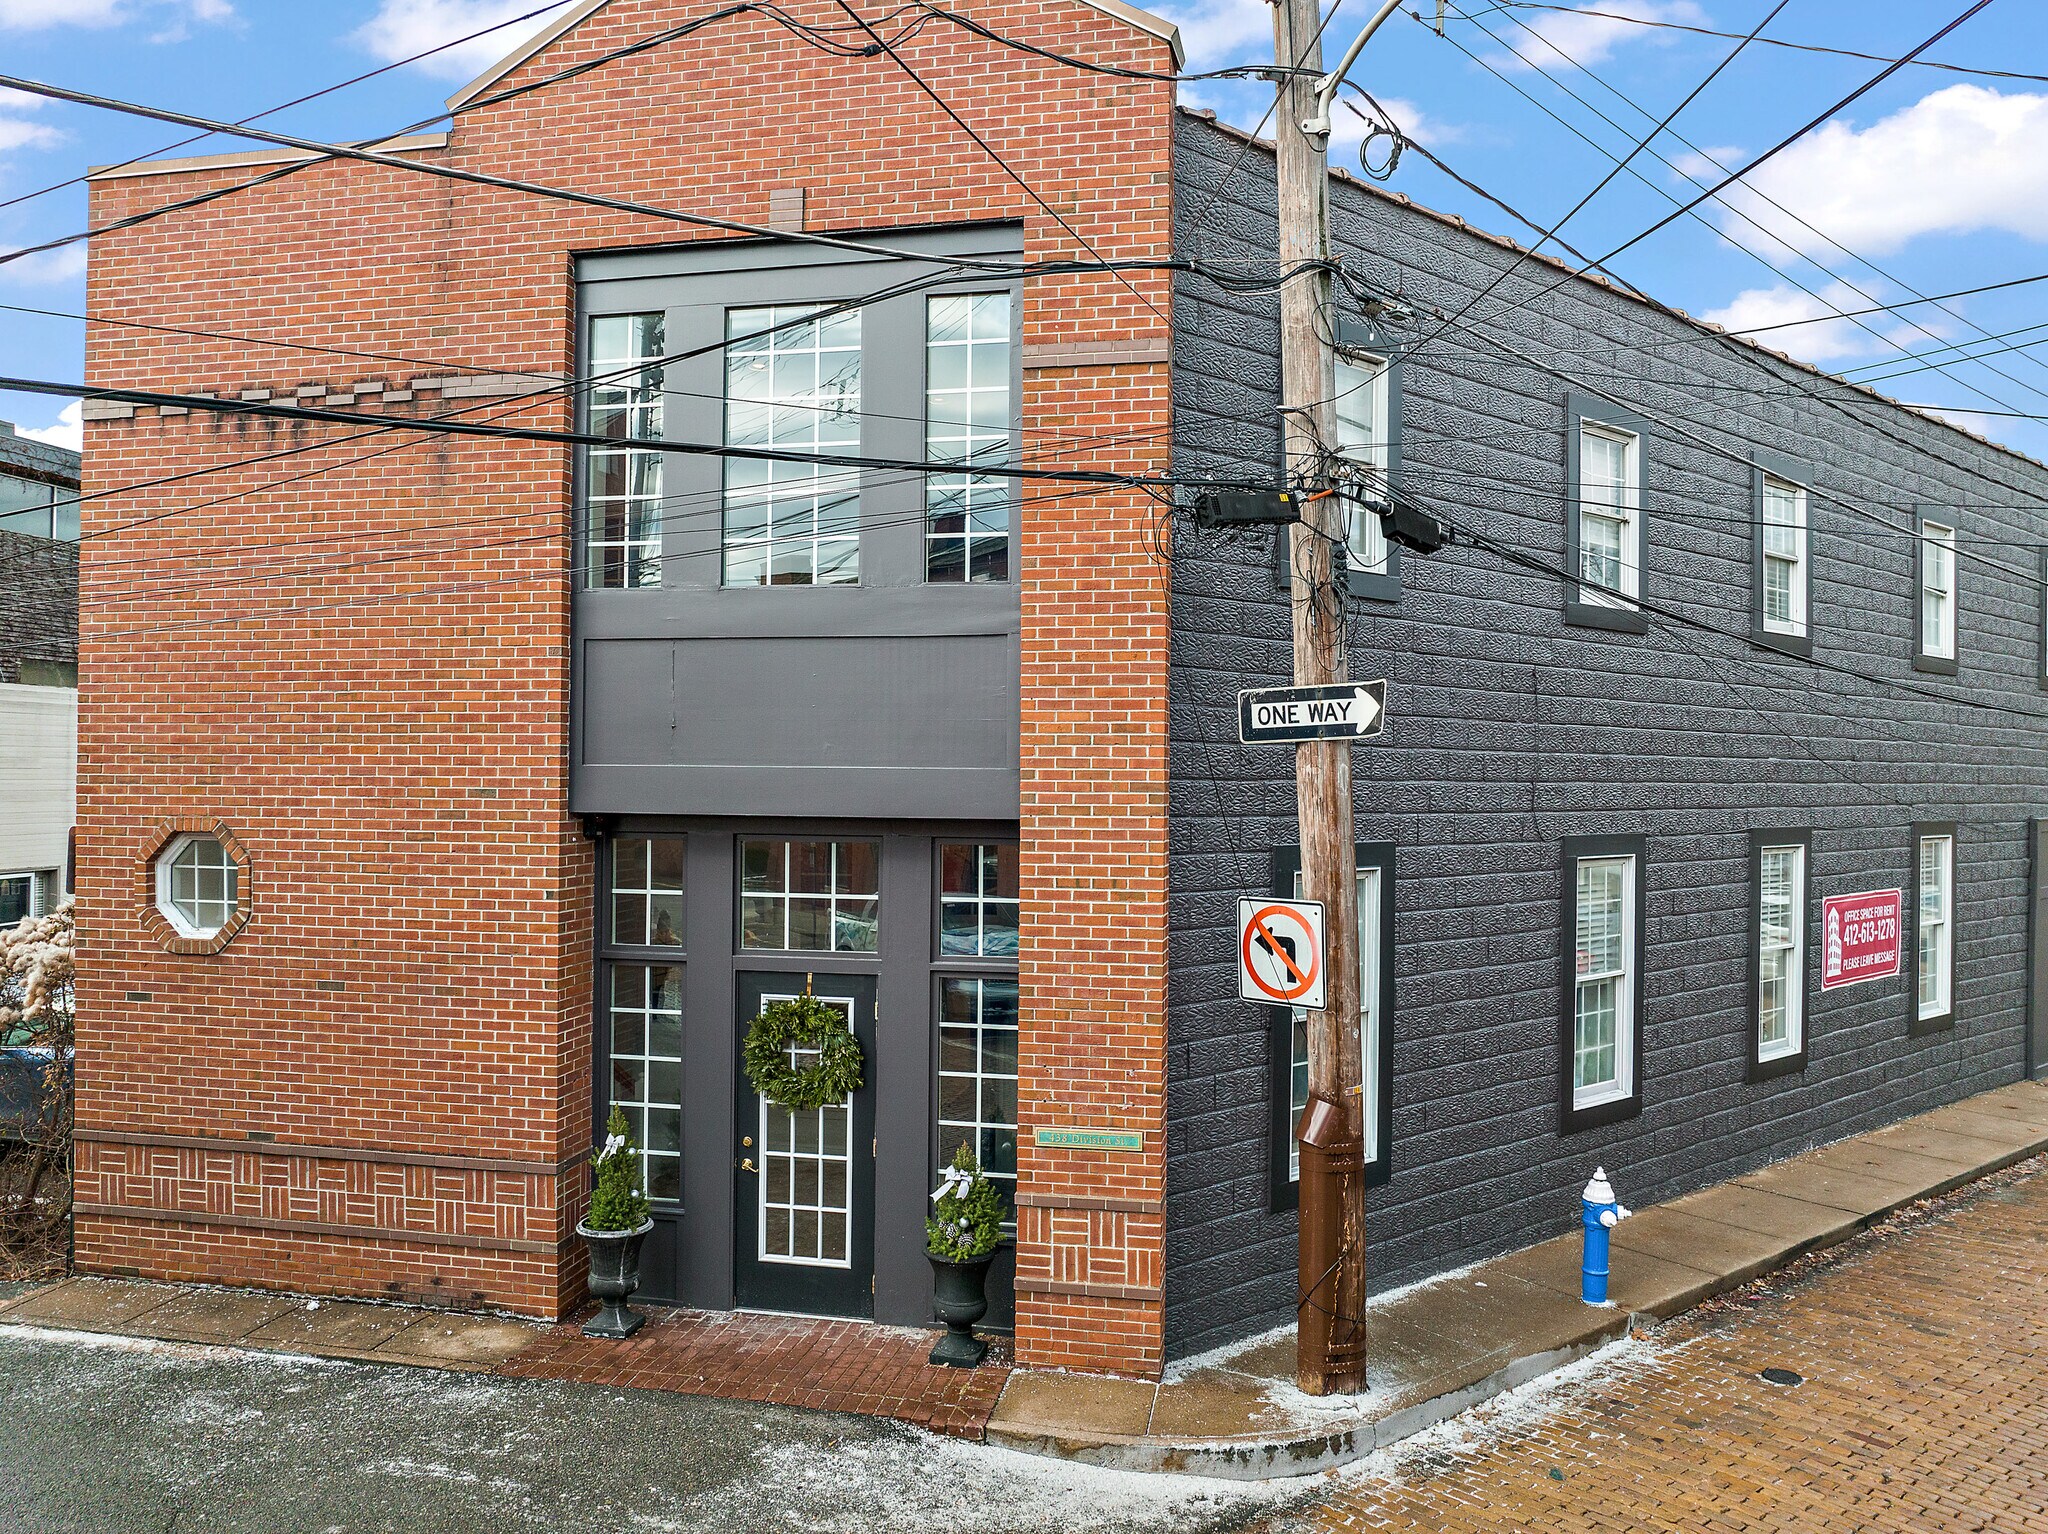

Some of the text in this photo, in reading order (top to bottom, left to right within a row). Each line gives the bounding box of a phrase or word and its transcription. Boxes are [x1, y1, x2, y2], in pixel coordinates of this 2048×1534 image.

[1257, 701, 1352, 725] ONE WAY
[1844, 905, 1895, 922] OFFICE SPACE FOR RENT
[1843, 918, 1895, 946] 412-613-1278
[1843, 950, 1895, 970] PLEASE LEAVE MESSAGE
[1072, 1135, 1112, 1144] Division
